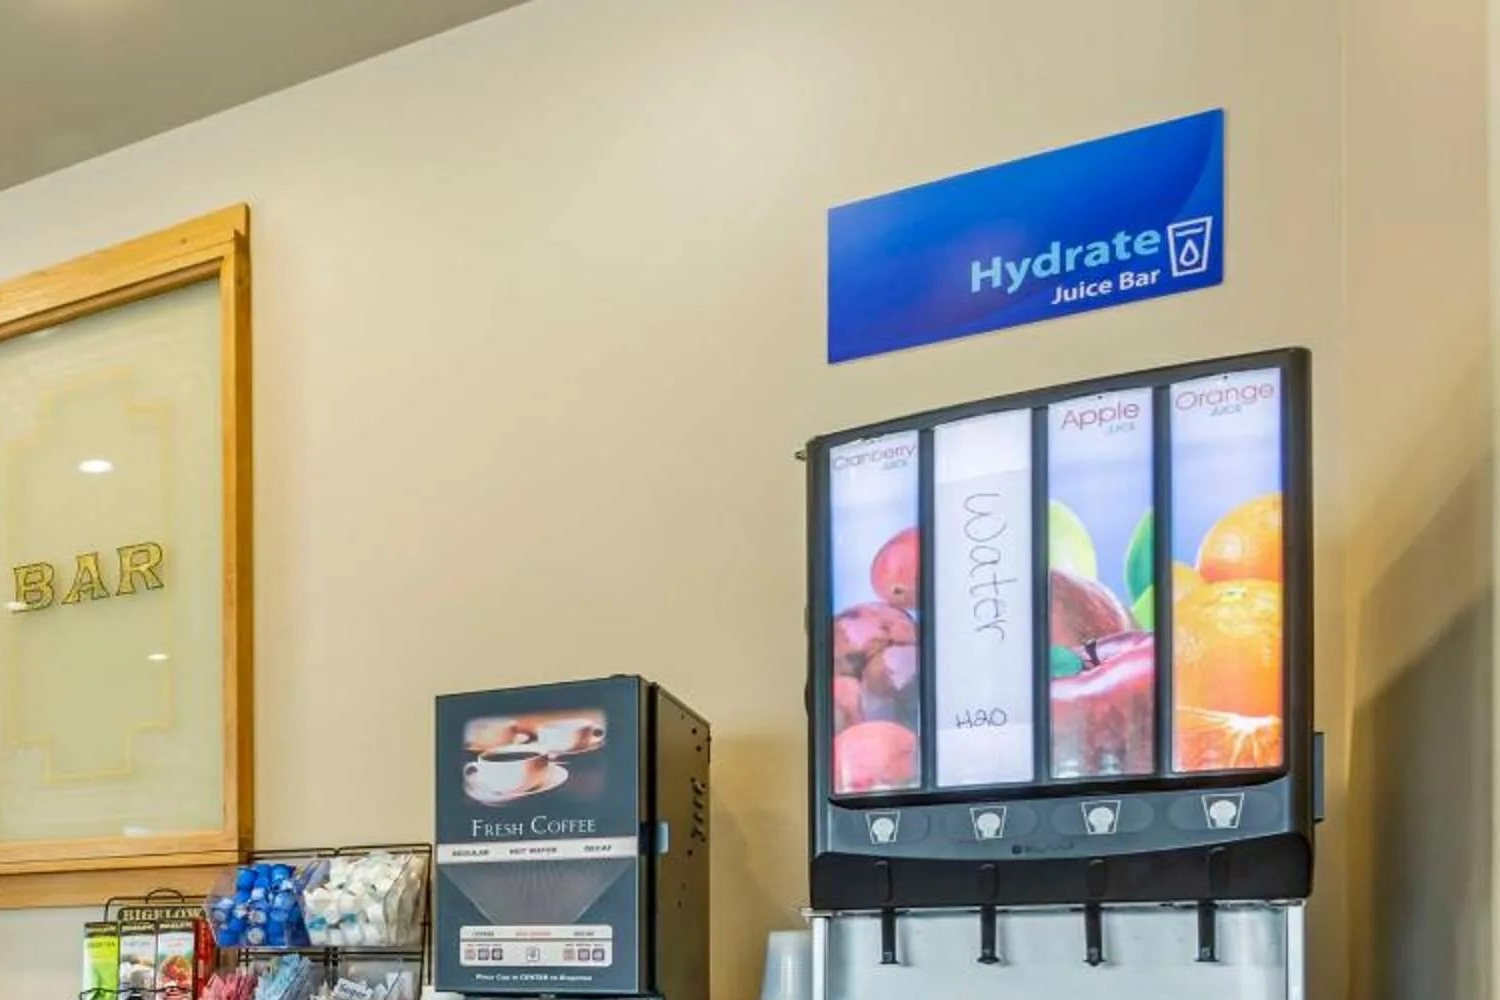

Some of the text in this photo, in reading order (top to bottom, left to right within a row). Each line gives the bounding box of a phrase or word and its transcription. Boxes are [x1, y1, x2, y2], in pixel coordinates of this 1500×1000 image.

[970, 229, 1161, 294] Hydrate
[1051, 268, 1161, 305] Juice Bar
[1174, 382, 1275, 411] Orange
[1061, 402, 1140, 432] Apple
[11, 541, 165, 613] BAR
[472, 815, 596, 837] FRESH COFFEE
